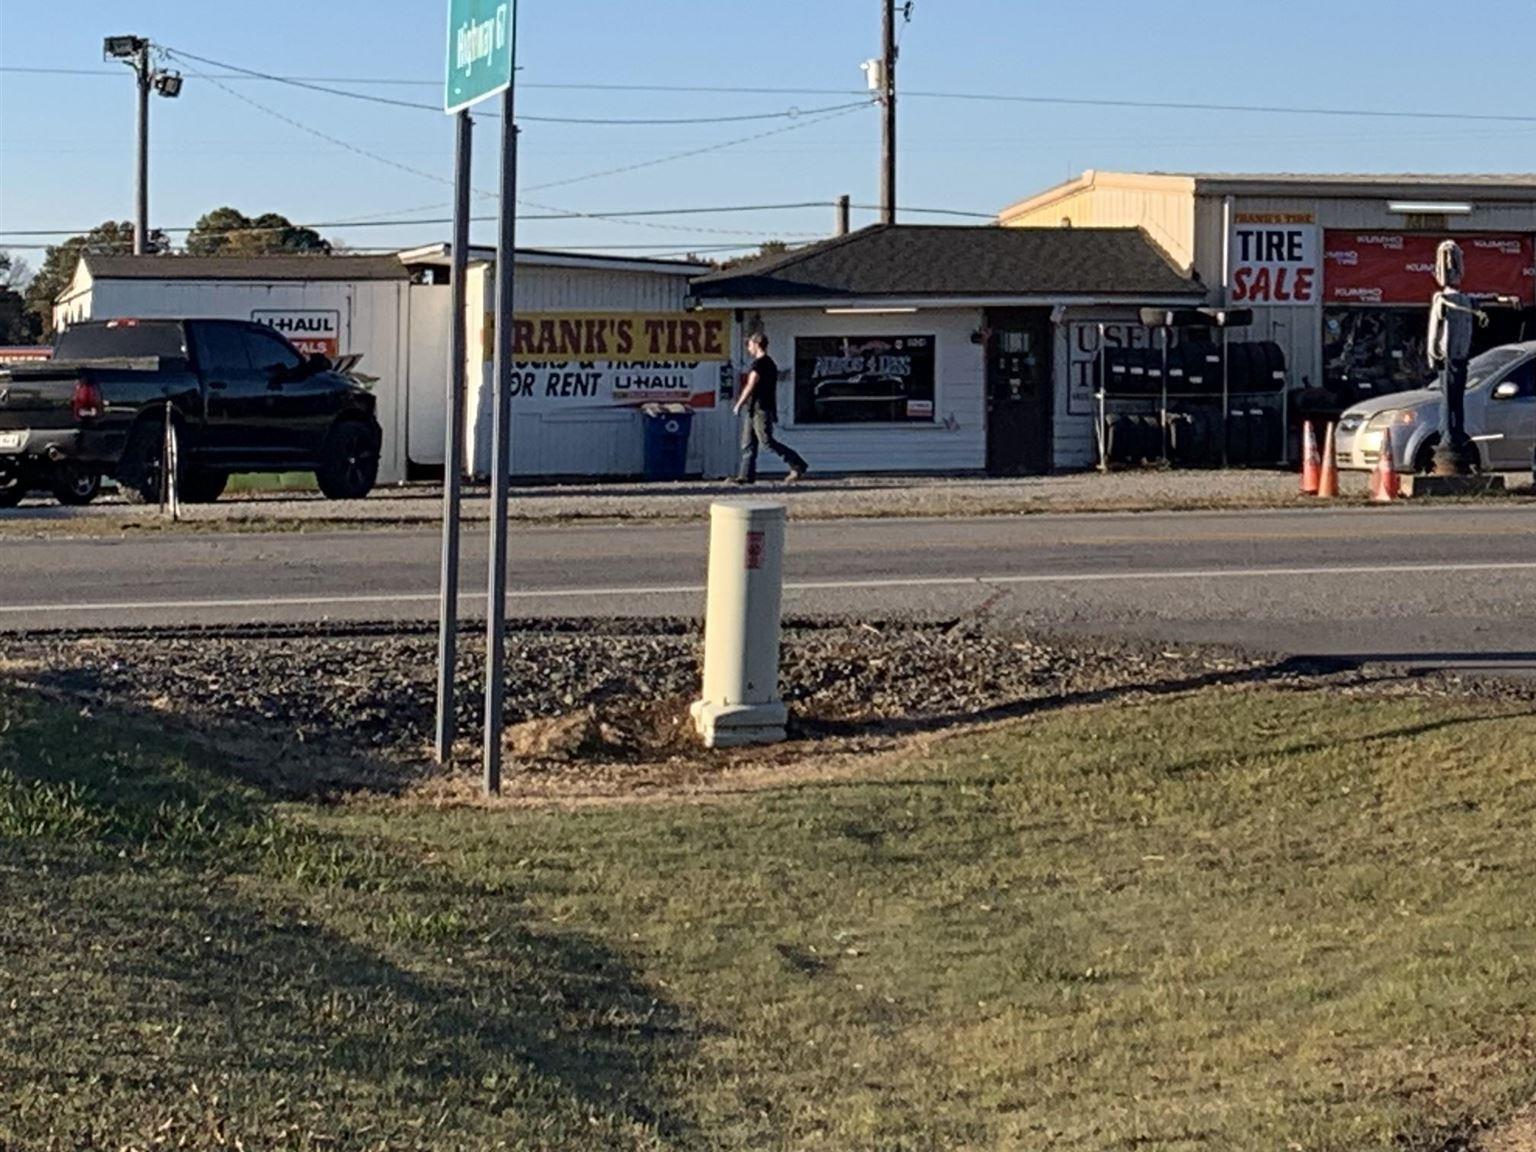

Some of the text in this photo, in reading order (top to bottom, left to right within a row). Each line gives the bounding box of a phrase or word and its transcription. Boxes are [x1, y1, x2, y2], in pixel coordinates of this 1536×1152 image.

[1237, 231, 1303, 261] TIRE
[1232, 267, 1315, 302] SALE
[491, 319, 632, 354] RANK'S
[645, 319, 723, 354] TIRE
[510, 372, 602, 397] OR RENT
[615, 376, 688, 388] U-HAUL
